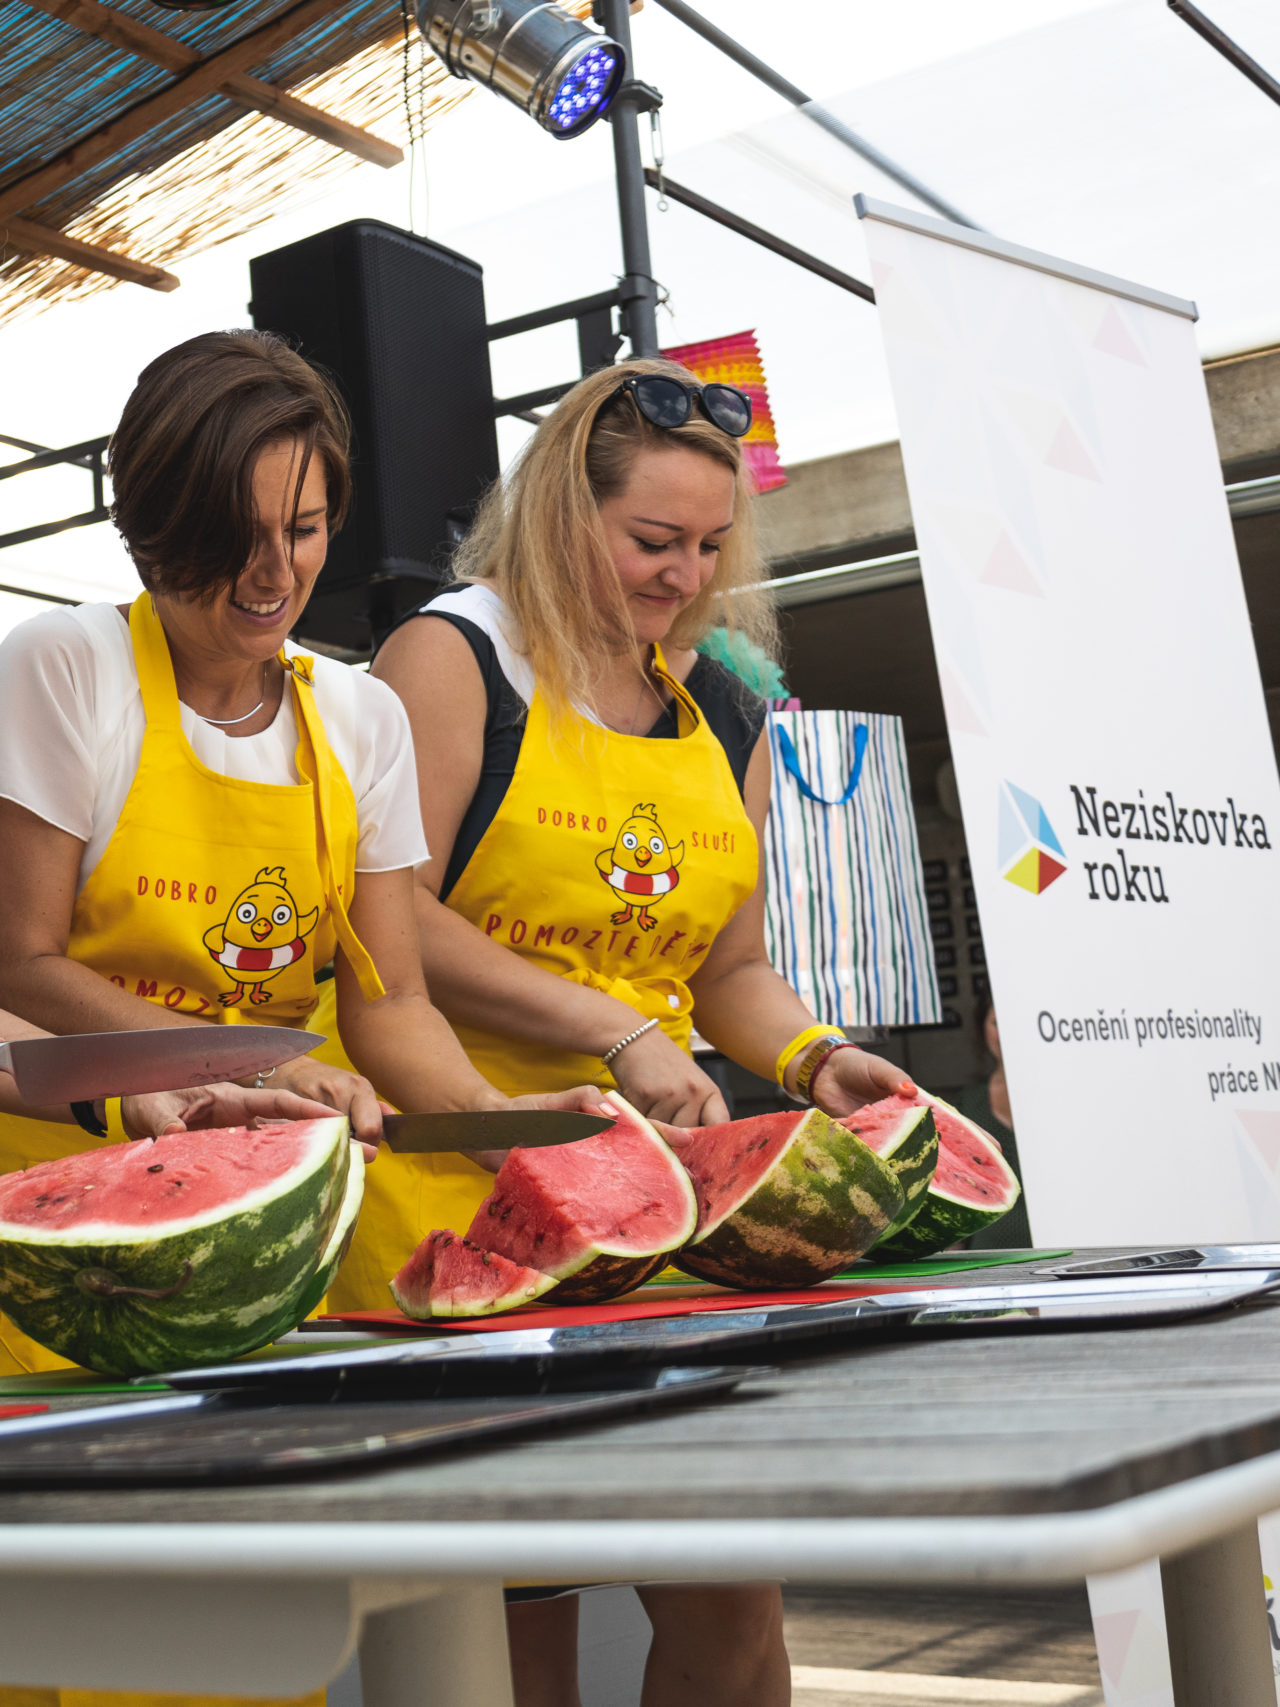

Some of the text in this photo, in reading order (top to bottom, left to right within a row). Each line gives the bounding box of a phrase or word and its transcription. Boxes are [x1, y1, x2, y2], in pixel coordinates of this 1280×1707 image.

[537, 807, 736, 854] DOBRO SLUŠÍ
[1069, 784, 1273, 850] Neziskovka
[137, 876, 217, 905] DOBRO
[1082, 848, 1170, 904] roku
[485, 913, 640, 958] POMOZTE
[1037, 1008, 1262, 1048] Ocenění profesionality
[1207, 1061, 1280, 1102] práce N
